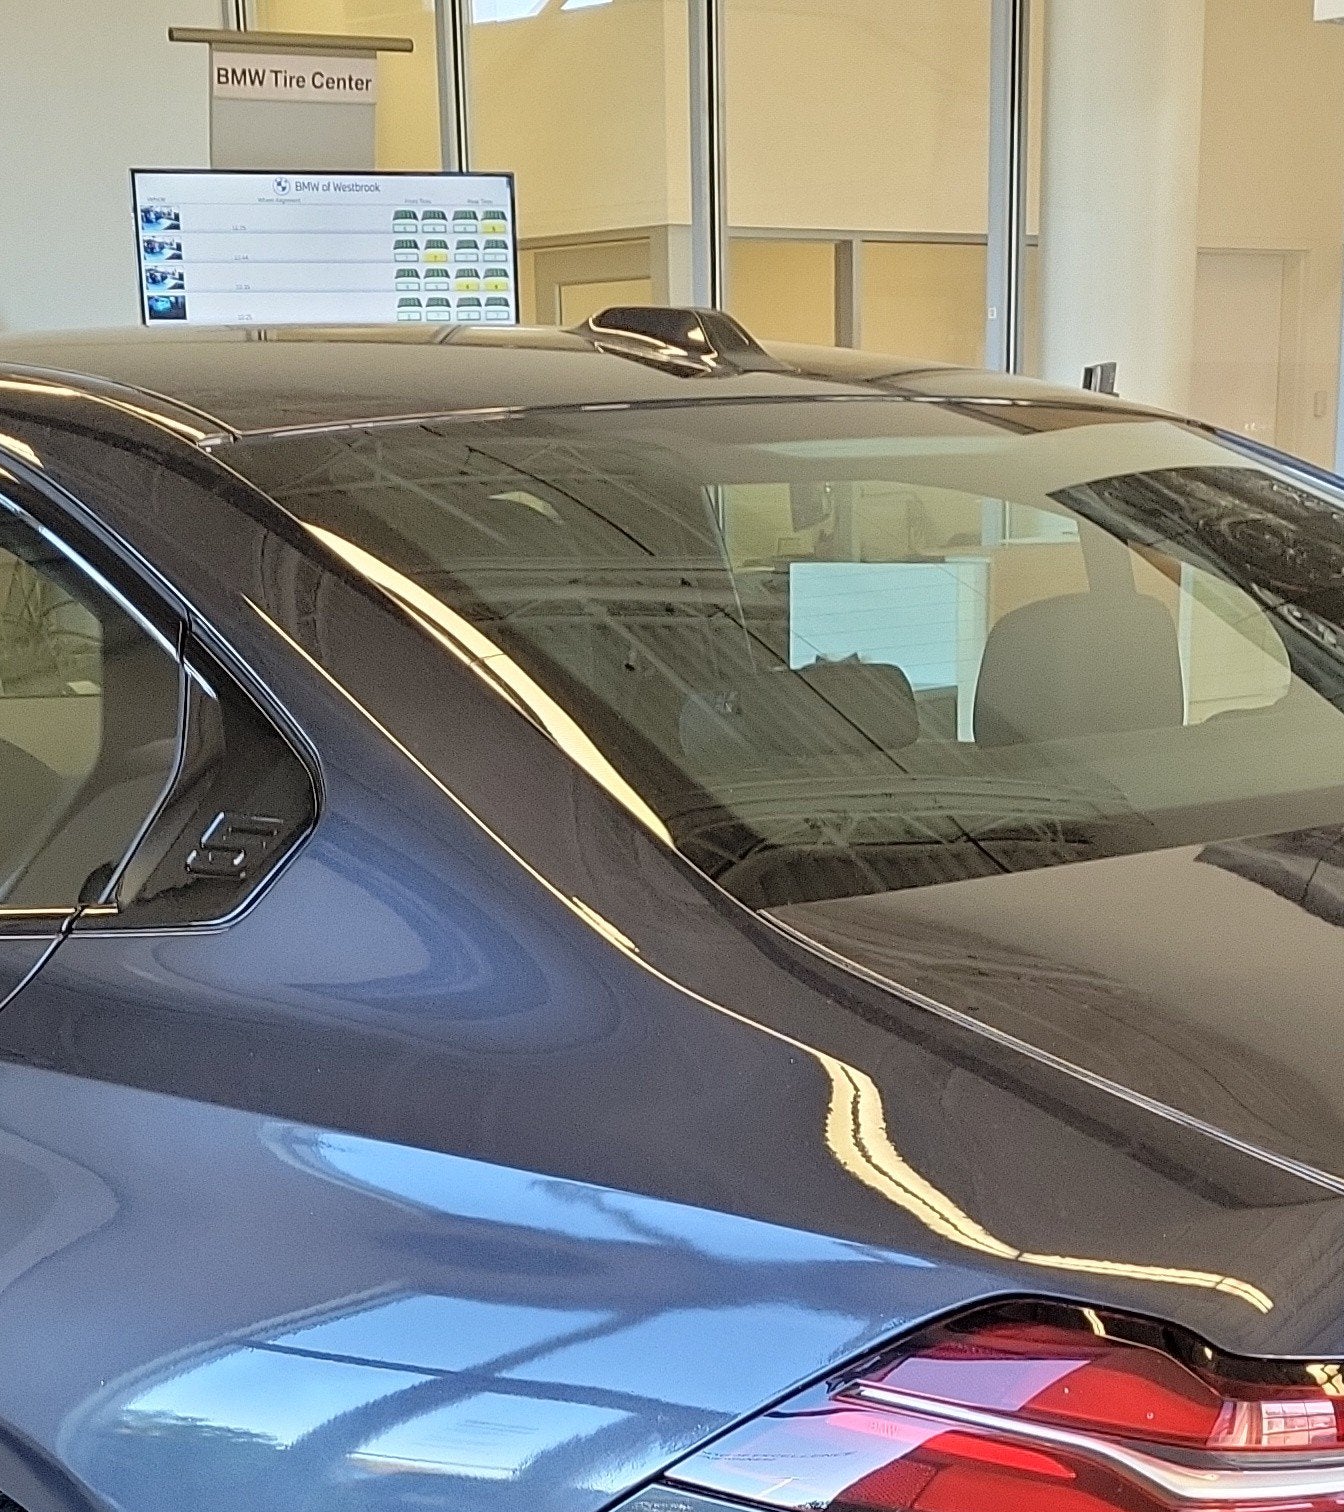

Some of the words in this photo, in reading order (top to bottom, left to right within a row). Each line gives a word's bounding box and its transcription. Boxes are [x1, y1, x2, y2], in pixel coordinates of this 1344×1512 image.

[216, 67, 266, 87] BMW
[269, 69, 306, 89] Tire
[311, 71, 373, 91] Center
[294, 180, 320, 192] BMW
[321, 181, 331, 192] of
[333, 181, 381, 193] Westbrook
